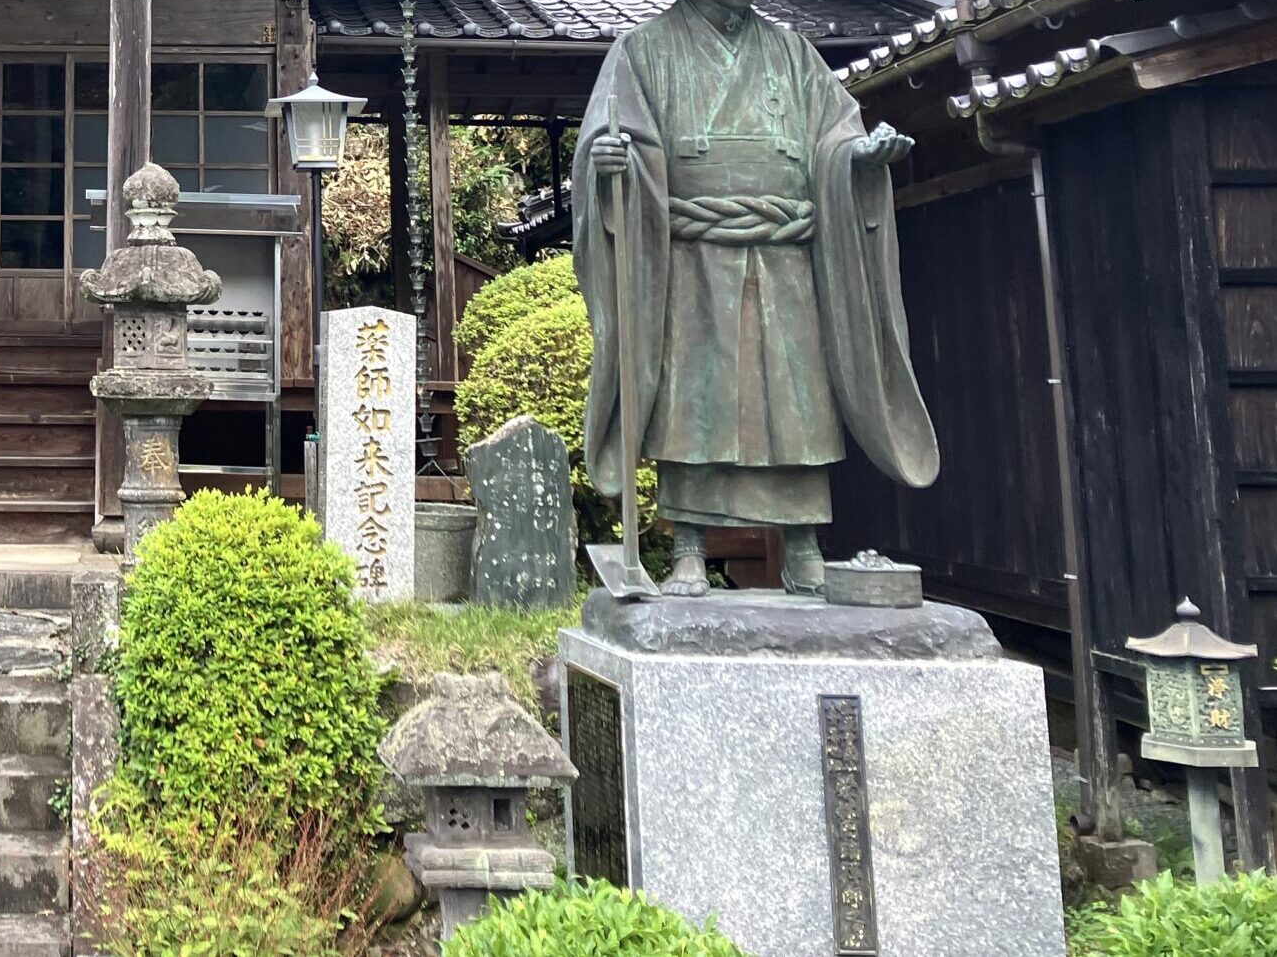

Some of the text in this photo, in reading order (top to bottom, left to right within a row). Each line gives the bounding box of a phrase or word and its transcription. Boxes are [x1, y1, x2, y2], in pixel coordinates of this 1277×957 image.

[138, 437, 171, 478] 奉
[351, 318, 394, 595] 薬師如来記念碑
